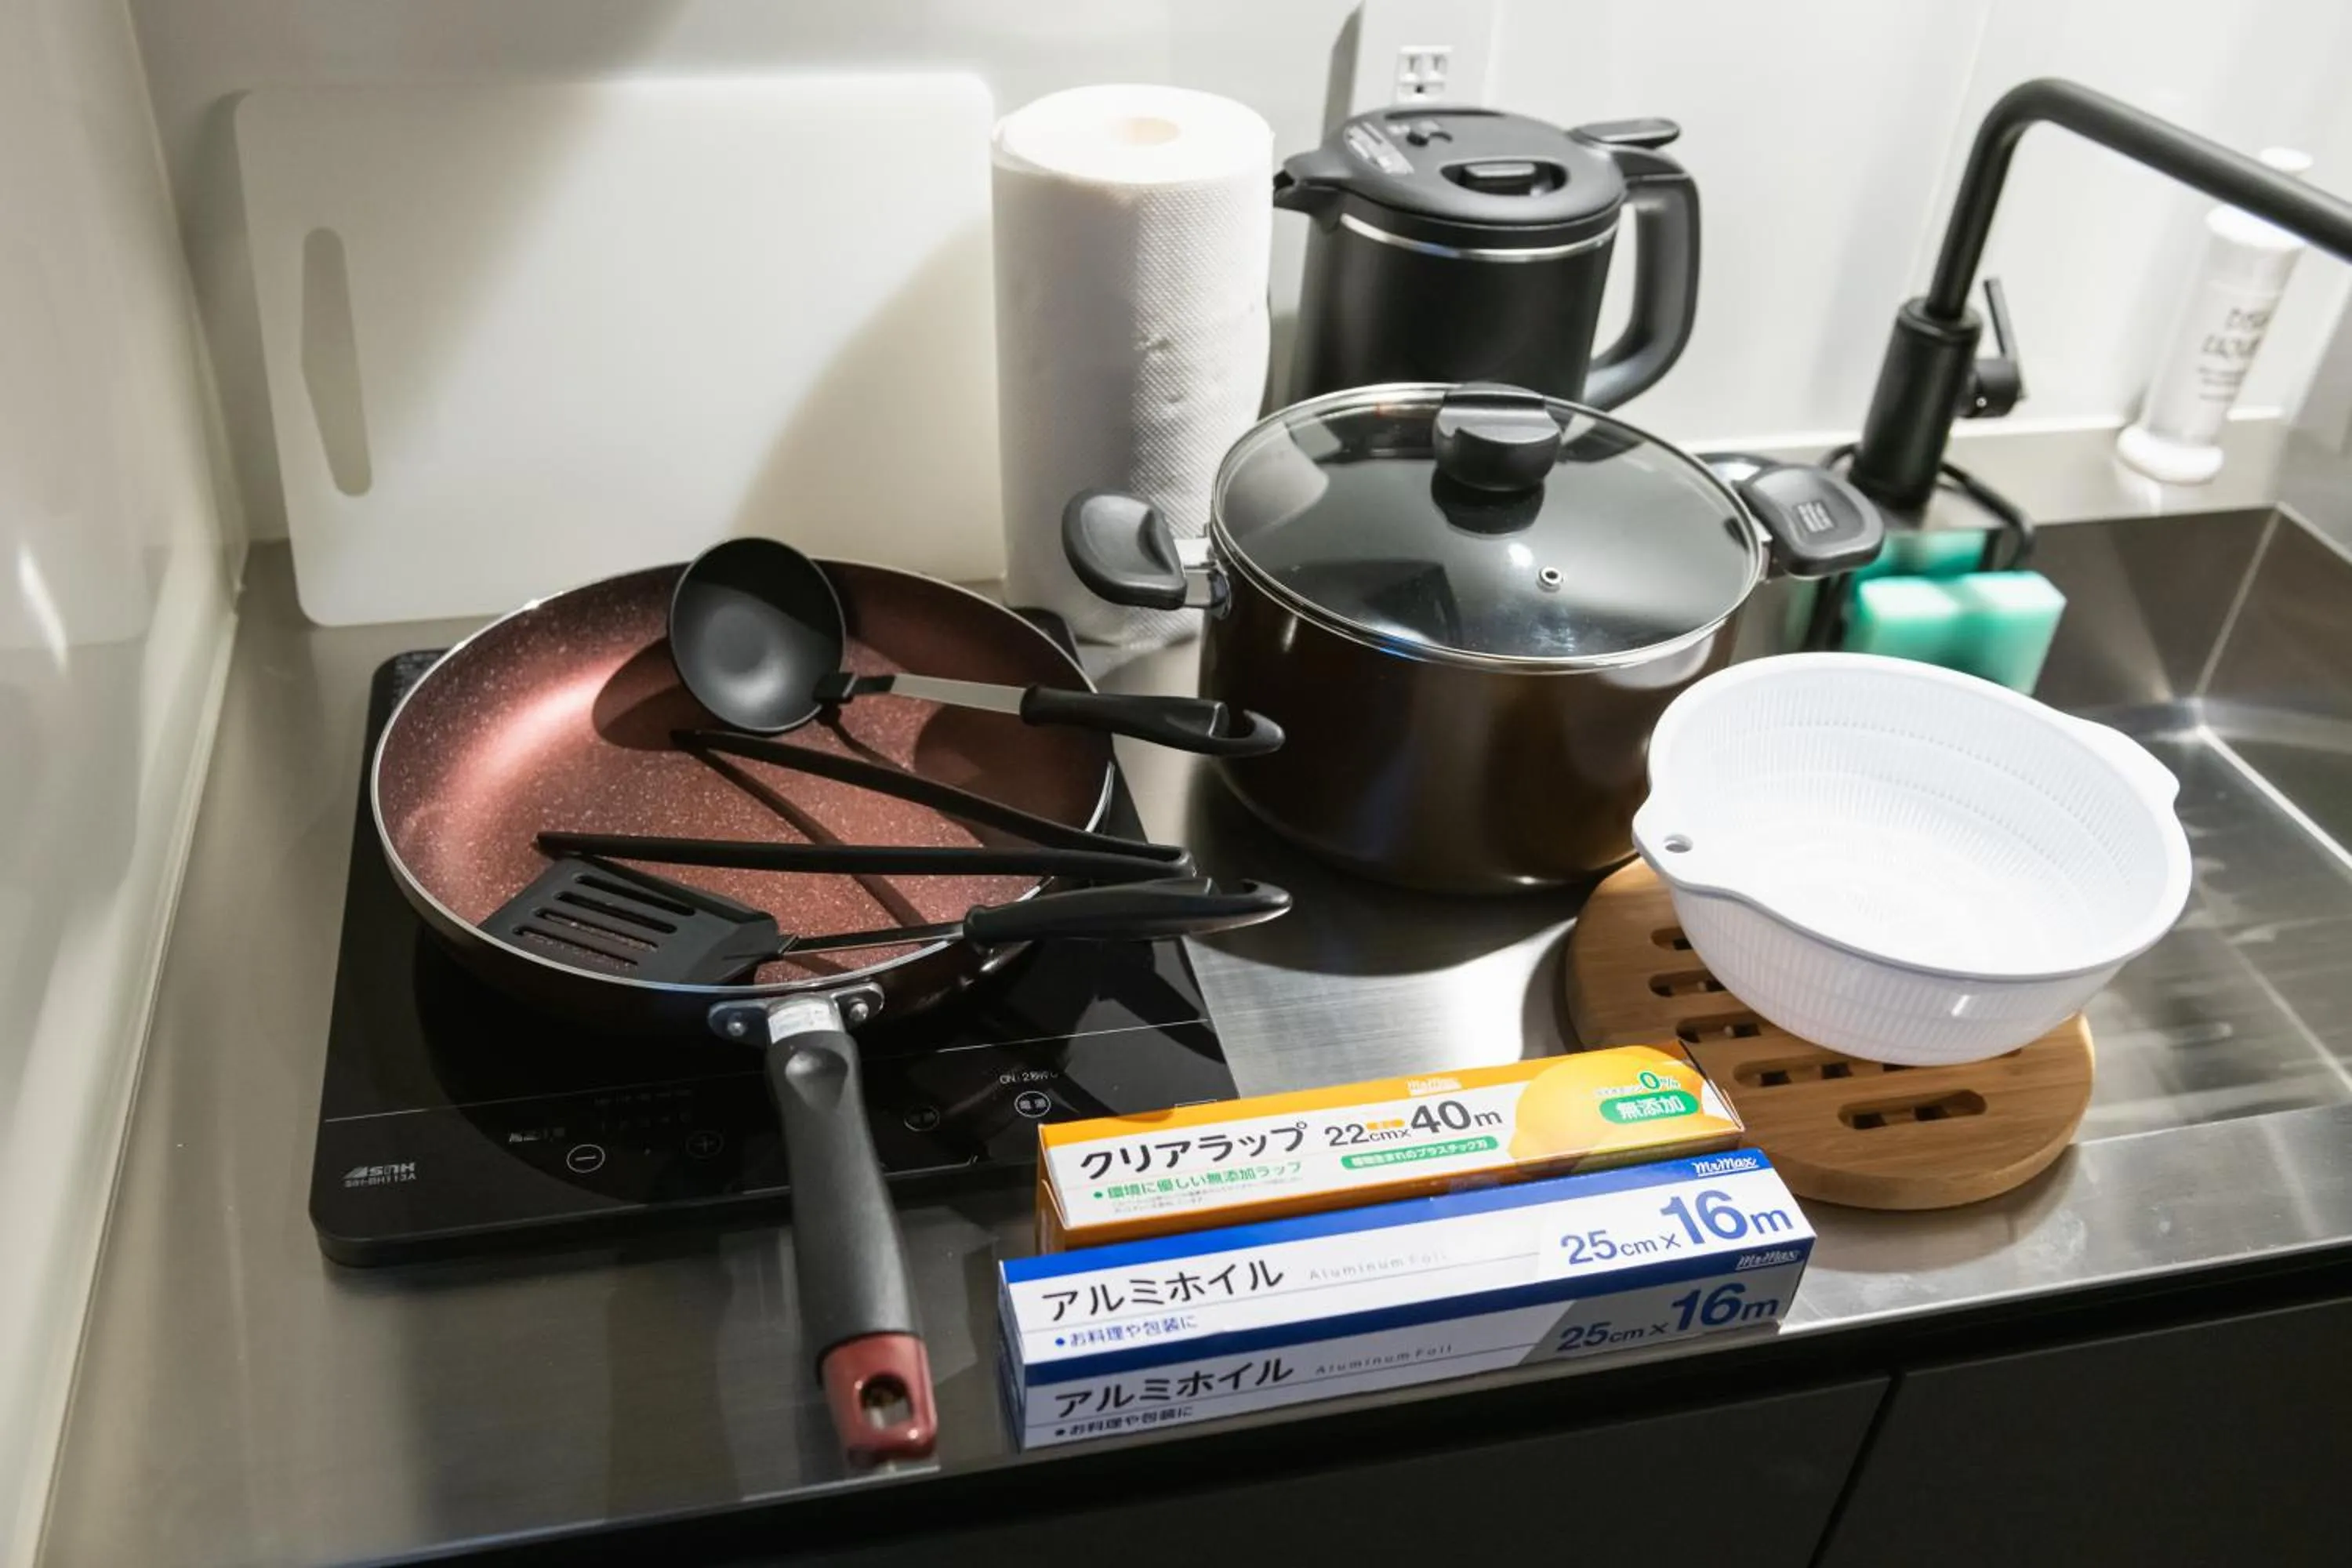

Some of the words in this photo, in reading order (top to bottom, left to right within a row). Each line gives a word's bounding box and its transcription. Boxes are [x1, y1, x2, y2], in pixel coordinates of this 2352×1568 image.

[1616, 1095, 1686, 1120] 無添加
[1080, 1121, 1307, 1180] クリアラップ
[1692, 1156, 1759, 1177] MrMax
[1043, 1260, 1283, 1321] アルミホイル
[1069, 1315, 1197, 1347] お料理や包装に
[1055, 1358, 1294, 1418] アルミホイル
[1069, 1406, 1193, 1435] お料理や包装に
